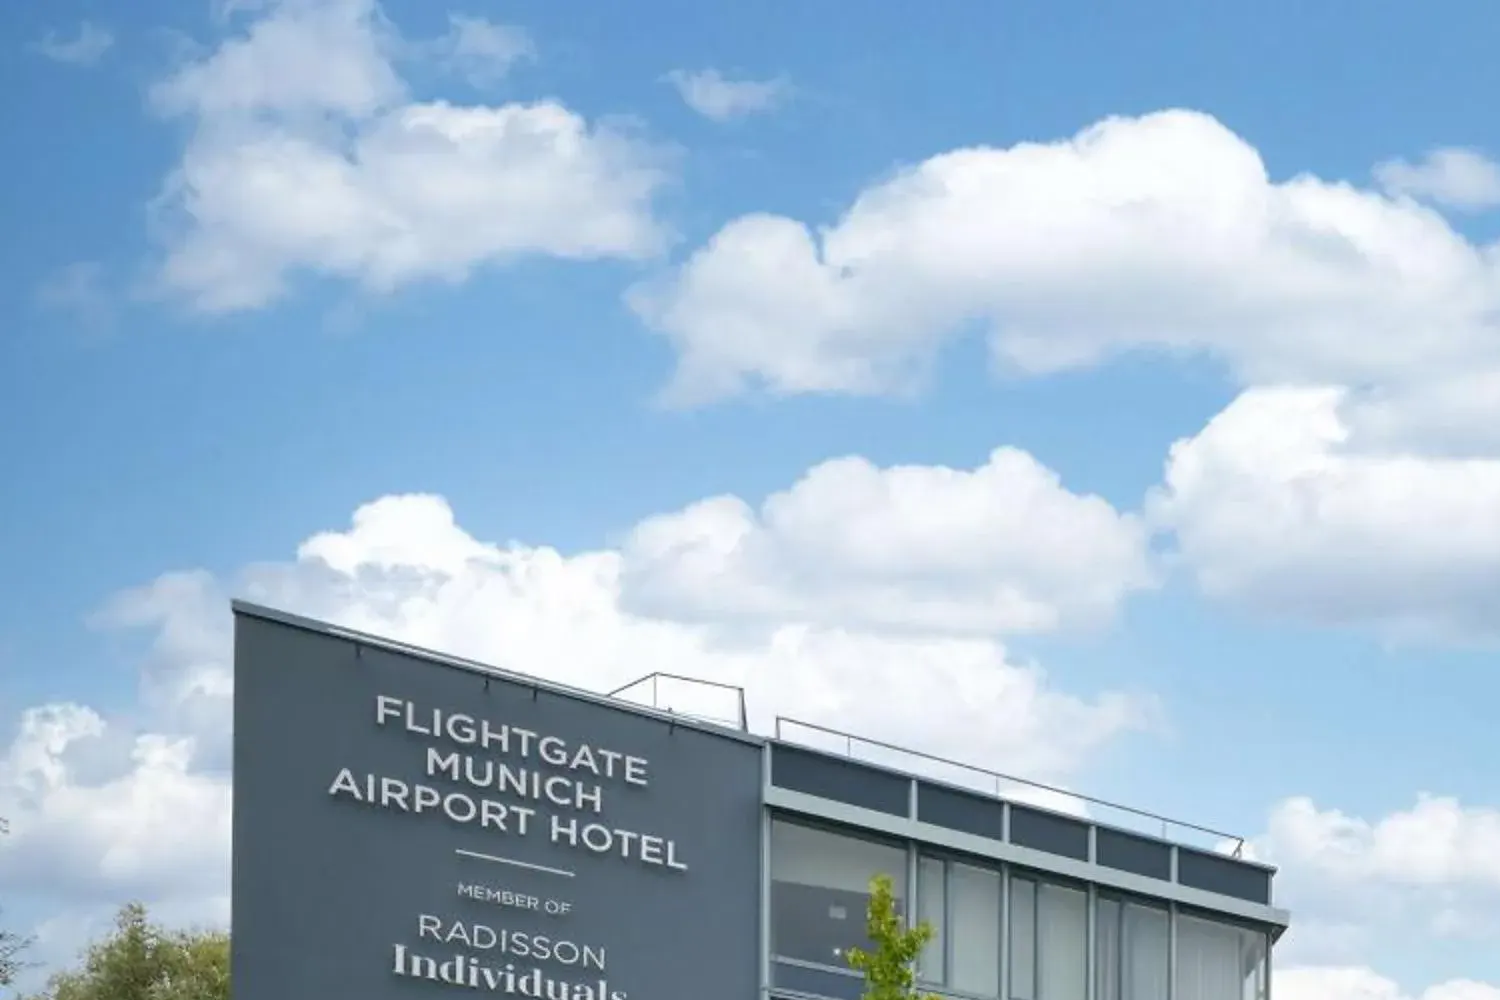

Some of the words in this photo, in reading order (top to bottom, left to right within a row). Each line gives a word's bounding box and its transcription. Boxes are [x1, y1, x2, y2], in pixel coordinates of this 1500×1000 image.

[377, 695, 649, 786] FLIGHTGATE
[427, 747, 602, 813] MUNICH
[328, 768, 536, 835] AIRPORT
[551, 815, 688, 870] HOTEL
[457, 882, 539, 911] MEMBER
[544, 899, 573, 916] OF
[418, 913, 606, 970] RADISSON
